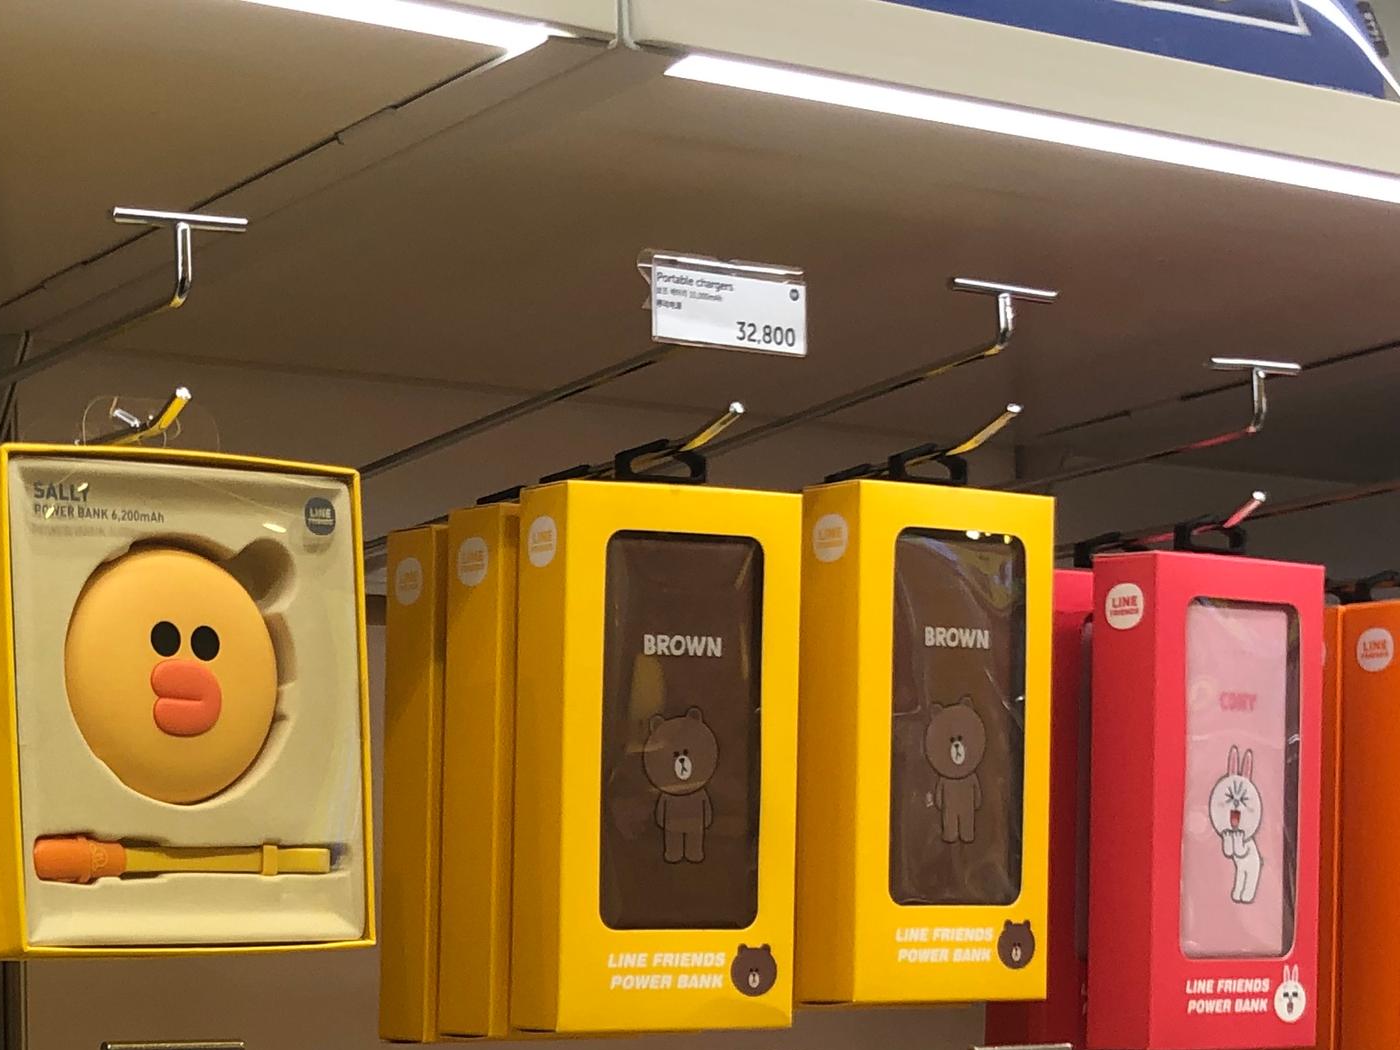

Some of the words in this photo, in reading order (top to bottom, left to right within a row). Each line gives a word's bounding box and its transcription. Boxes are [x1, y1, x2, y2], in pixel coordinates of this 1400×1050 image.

[656, 271, 694, 287] Portable
[695, 278, 734, 293] chargers
[736, 321, 796, 347] 32,800
[33, 482, 90, 502] SALLY
[78, 506, 108, 521] BANK
[111, 508, 165, 524] 6,200mAh
[309, 507, 332, 519] LINE
[1111, 595, 1138, 608] LINE
[643, 633, 722, 658] BROWN
[924, 626, 990, 650] BROWN
[1363, 639, 1387, 652] LINE
[895, 927, 930, 942] LINE
[932, 926, 994, 942] FRIENDS
[608, 953, 647, 968] LINE
[653, 952, 726, 968] FRIENDS
[897, 948, 950, 963] POWER
[953, 947, 992, 962] BANK
[610, 974, 673, 990] POWER
[677, 973, 724, 989] BANK
[1186, 979, 1214, 994] LINE
[1217, 977, 1270, 993] FRIENDS
[1187, 998, 1232, 1014] POWER
[1235, 998, 1268, 1013] BANK
